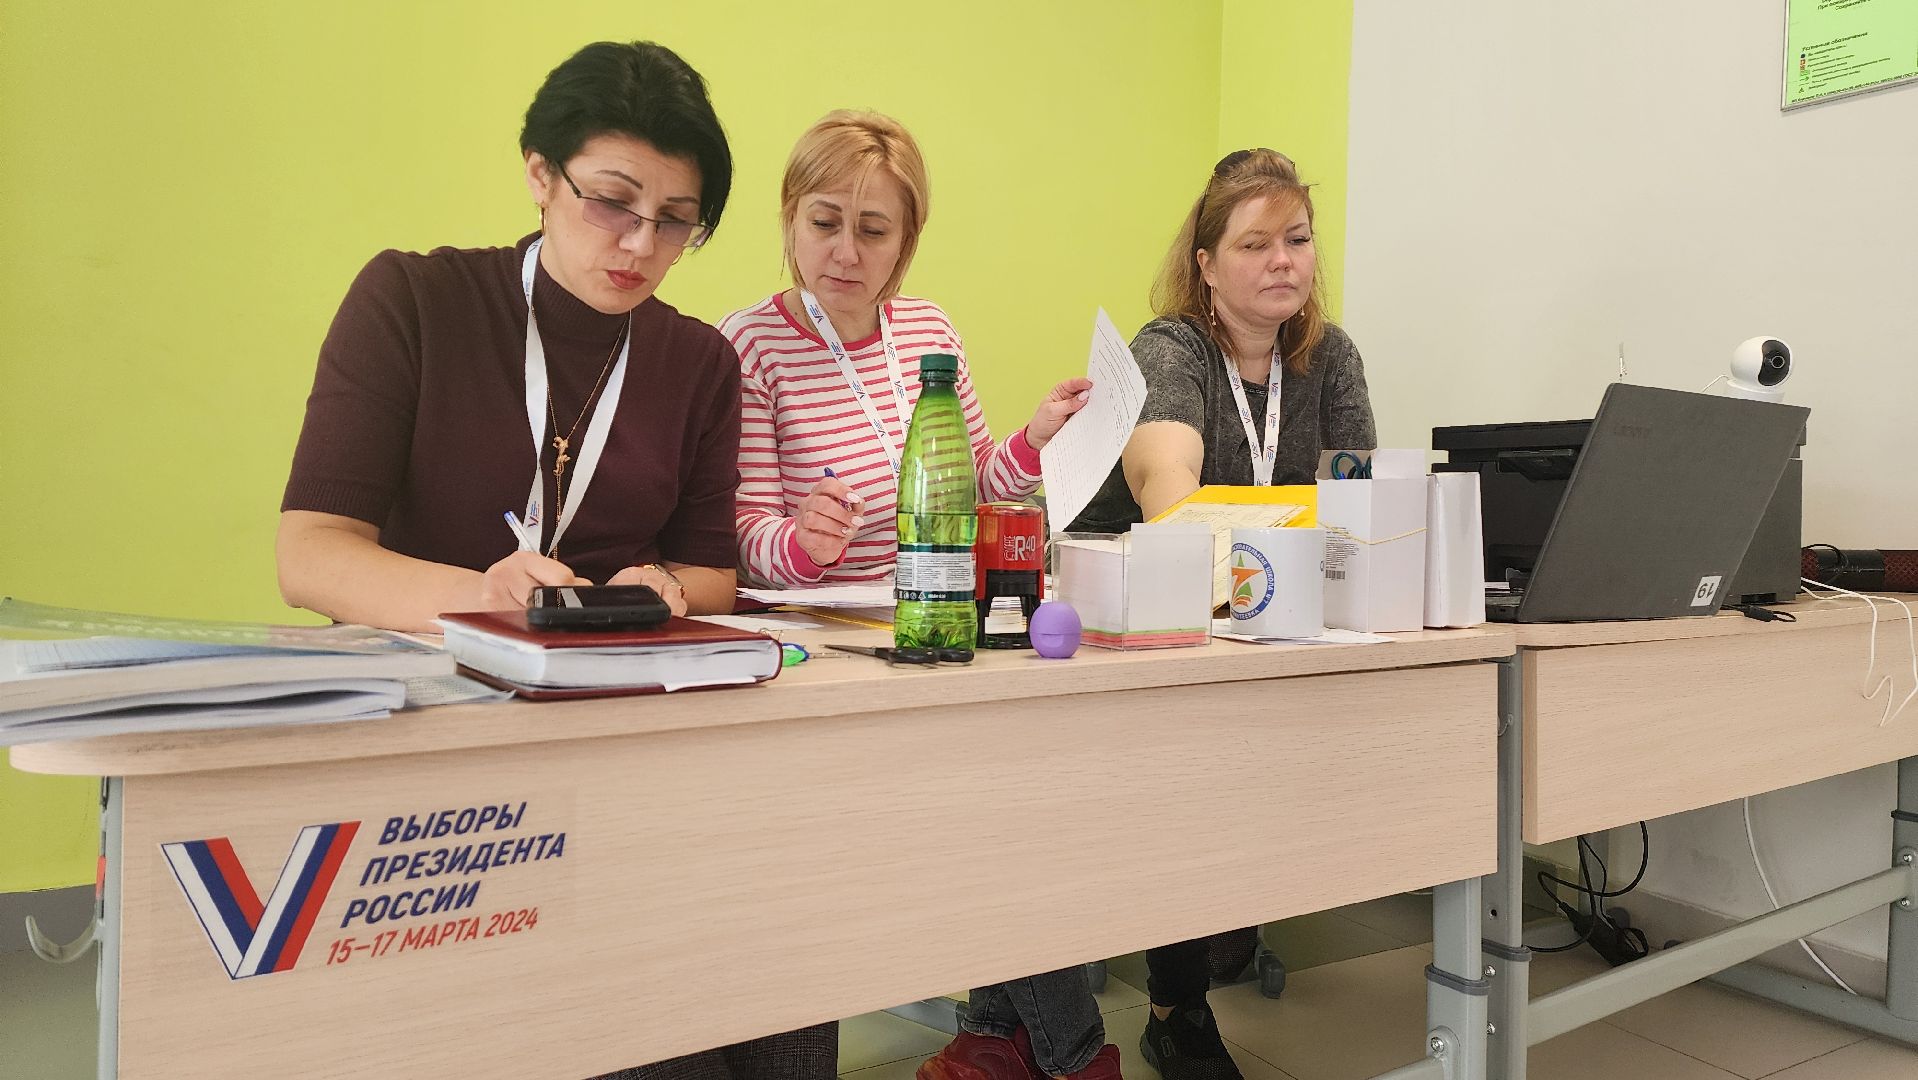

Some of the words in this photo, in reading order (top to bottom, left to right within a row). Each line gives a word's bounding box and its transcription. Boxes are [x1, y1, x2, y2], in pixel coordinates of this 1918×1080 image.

[1265, 566, 1274, 591] ШКОЛА
[379, 801, 528, 846] ВЫБОРЫ
[359, 833, 567, 887] ПРЕЗИДЕНТА
[340, 881, 481, 928] РОССИИ
[400, 916, 478, 953] МАРТА
[483, 906, 539, 938] 2024
